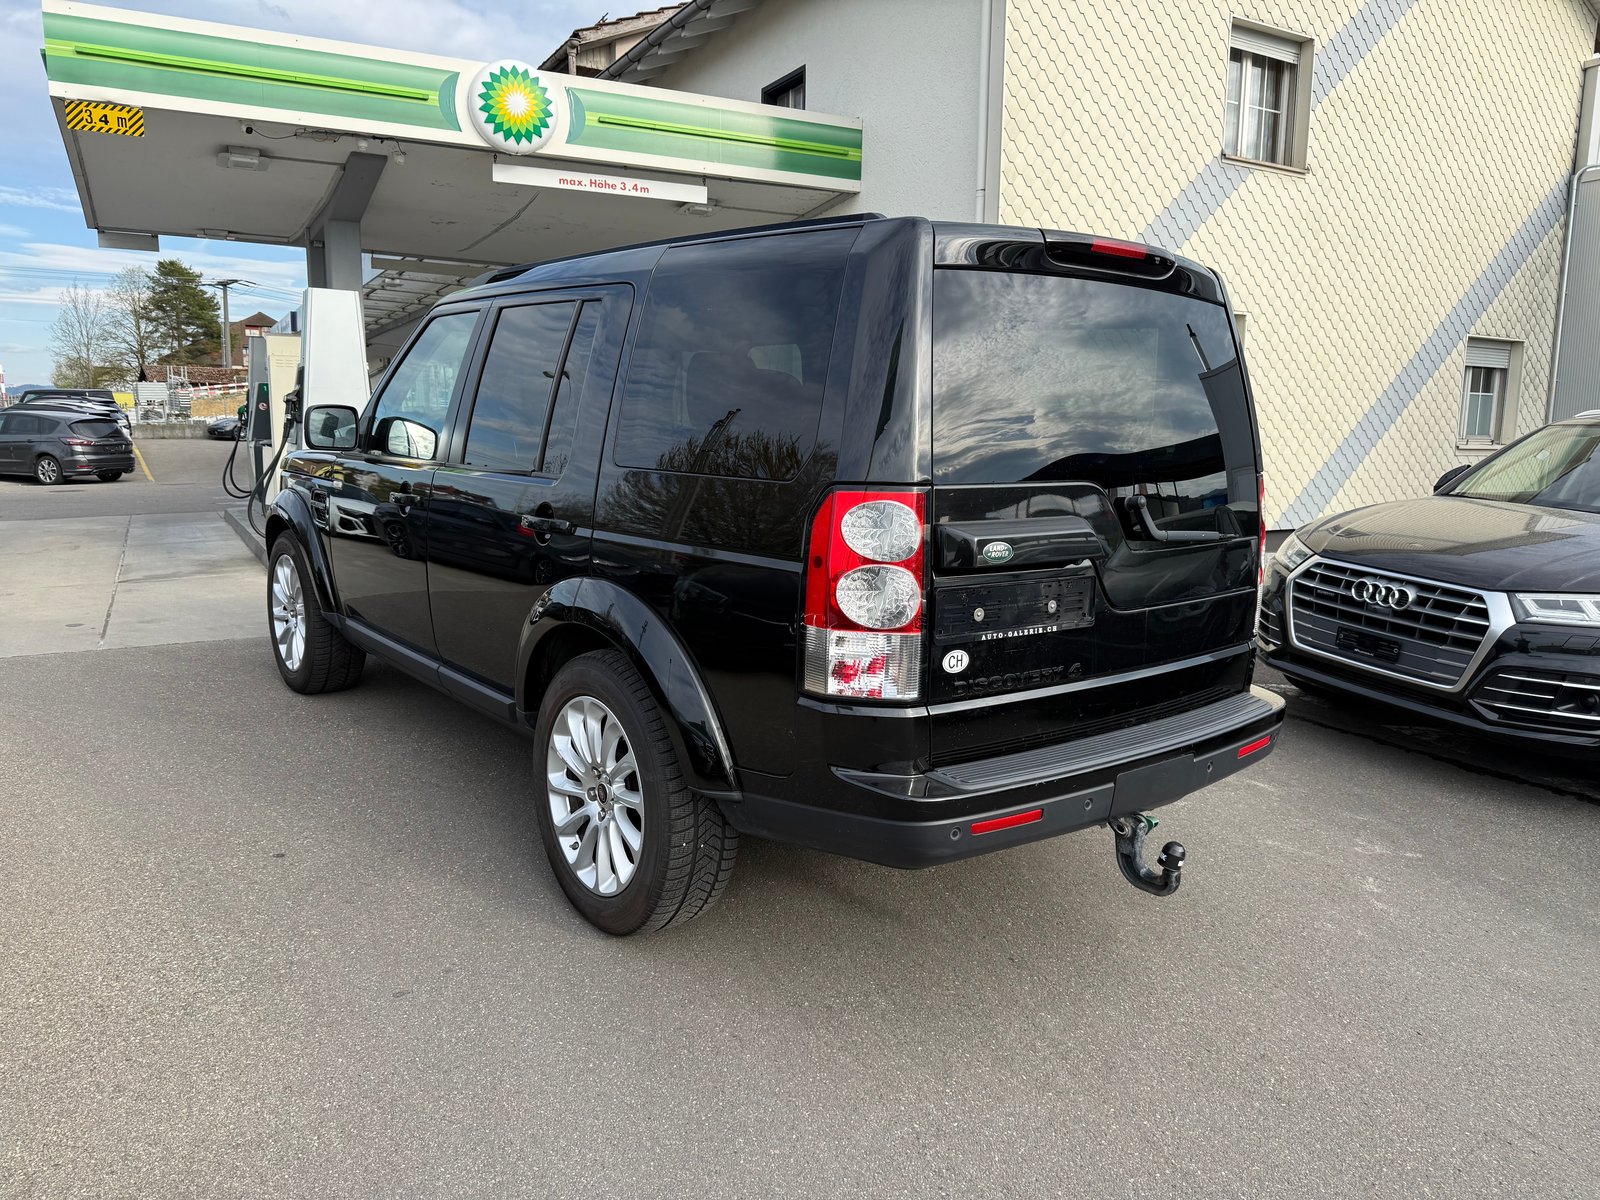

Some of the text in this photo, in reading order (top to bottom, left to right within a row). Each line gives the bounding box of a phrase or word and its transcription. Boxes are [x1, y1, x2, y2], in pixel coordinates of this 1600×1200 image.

[84, 108, 128, 129] 3.4 m
[558, 177, 587, 188] max.
[589, 178, 618, 191] Höhe
[989, 544, 1005, 552] LAND
[990, 550, 1010, 558] ROVER
[981, 625, 1058, 641] AUTO-GALERIE.CH
[948, 654, 964, 669] CH
[951, 665, 1065, 698] DISCOVERY
